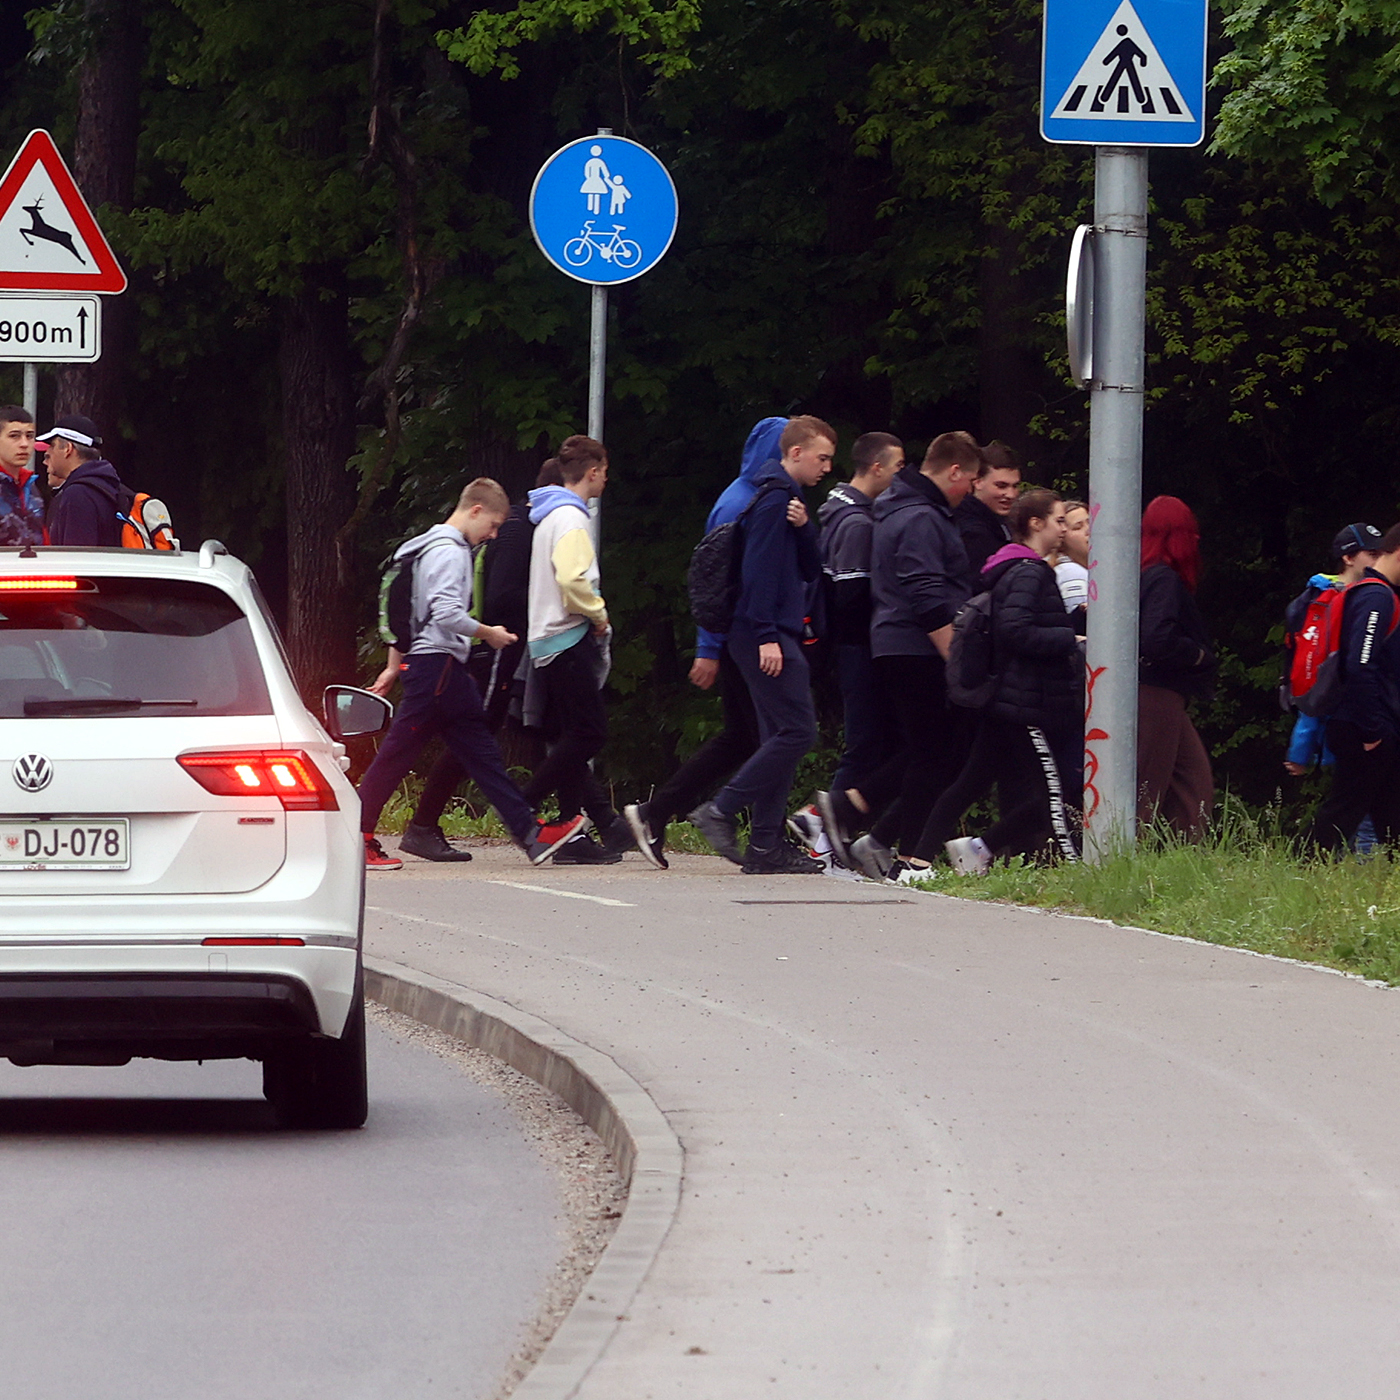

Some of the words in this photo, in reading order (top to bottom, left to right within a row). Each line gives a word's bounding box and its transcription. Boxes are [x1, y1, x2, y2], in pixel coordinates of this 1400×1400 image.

[1366, 610, 1380, 634] HELLY
[1360, 634, 1374, 664] HANSEN
[24, 828, 120, 857] DJ-078
